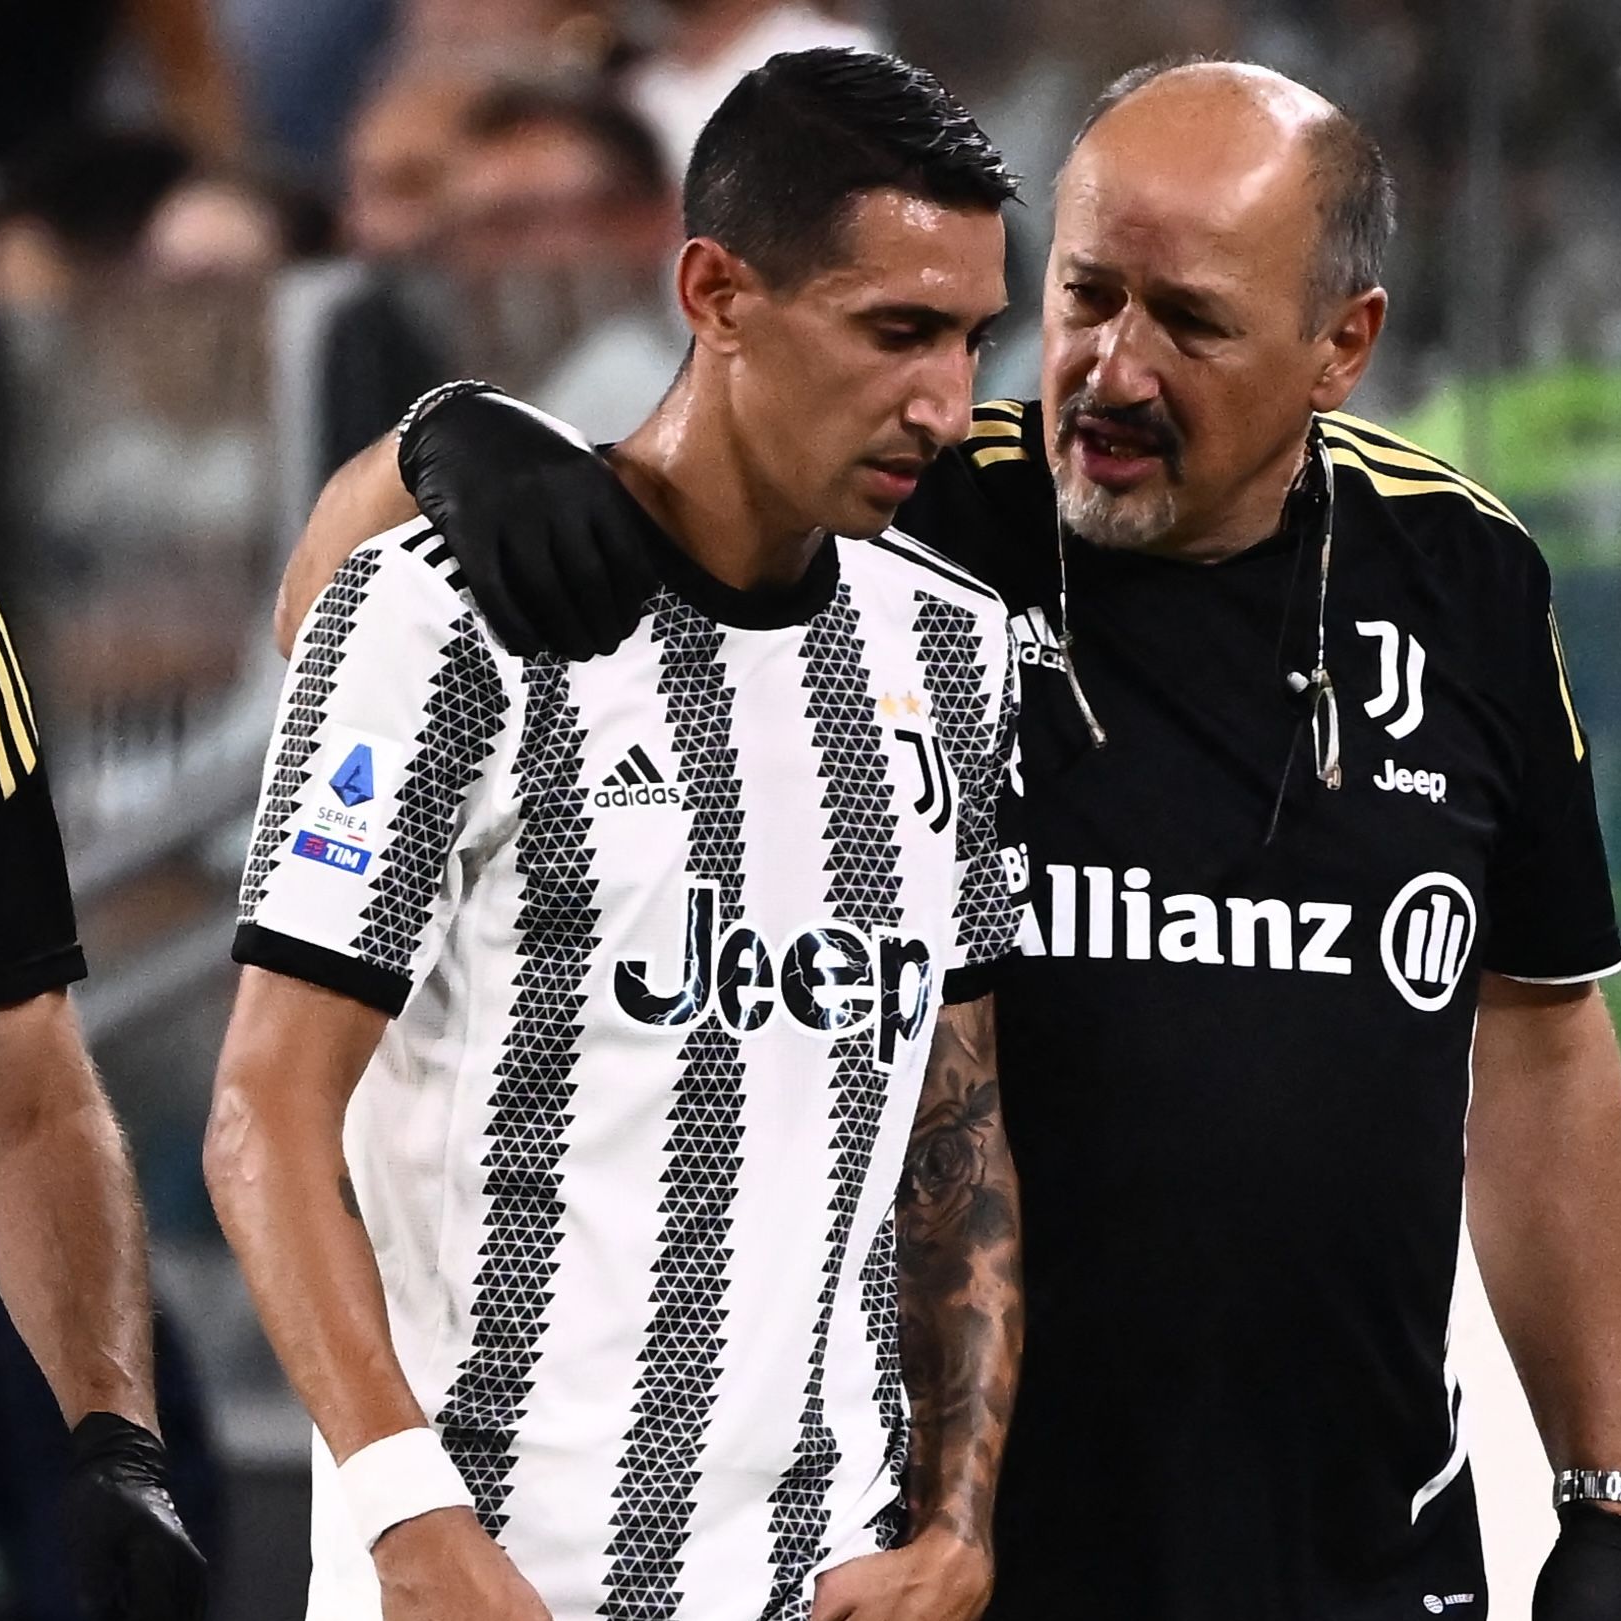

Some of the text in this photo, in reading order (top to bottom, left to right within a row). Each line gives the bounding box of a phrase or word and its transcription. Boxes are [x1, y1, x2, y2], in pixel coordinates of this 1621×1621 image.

[1373, 759, 1447, 802] Jeep
[594, 783, 680, 808] adidas
[316, 806, 368, 833] SERIE A
[325, 842, 361, 870] TIM
[613, 879, 934, 1067] Jeep
